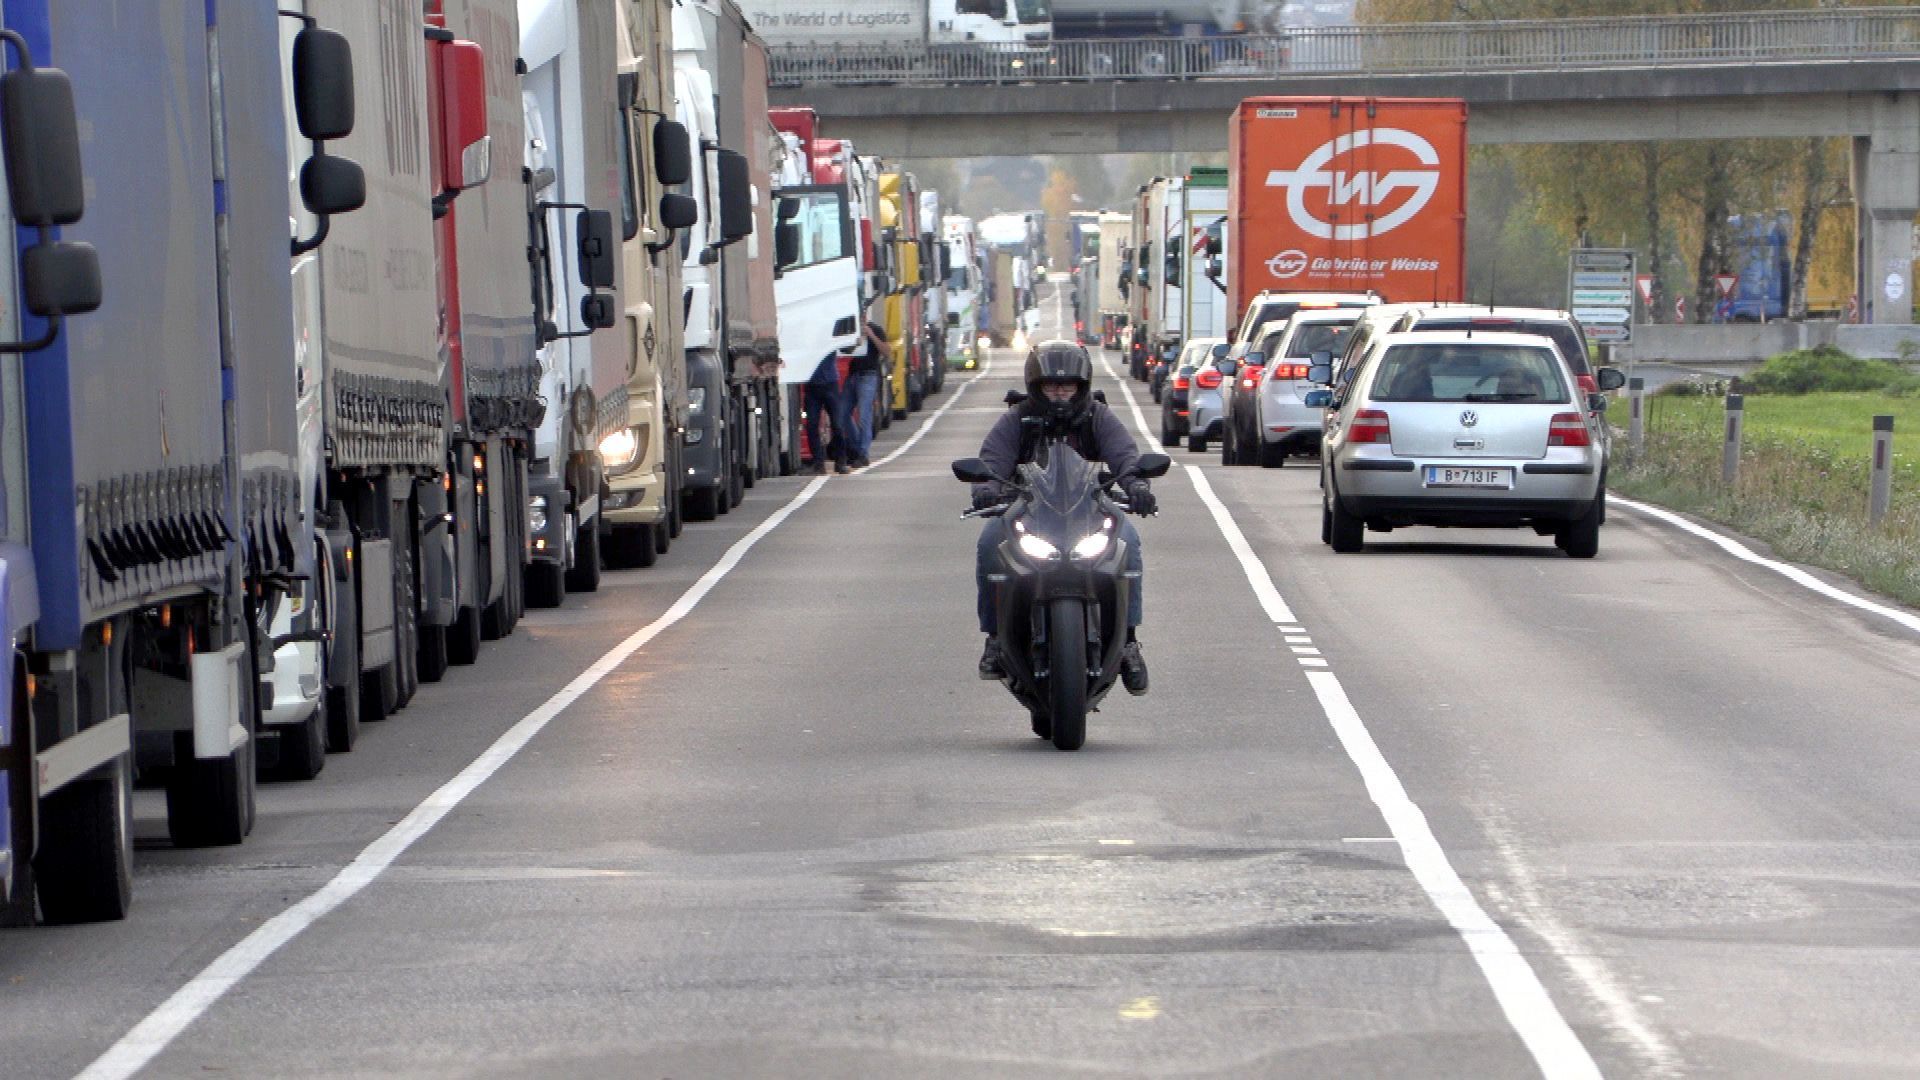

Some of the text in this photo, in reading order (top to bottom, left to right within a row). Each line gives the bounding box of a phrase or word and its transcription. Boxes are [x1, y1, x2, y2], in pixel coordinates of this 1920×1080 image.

[753, 11, 911, 28] The World of Logistics
[1391, 257, 1440, 271] Weiss
